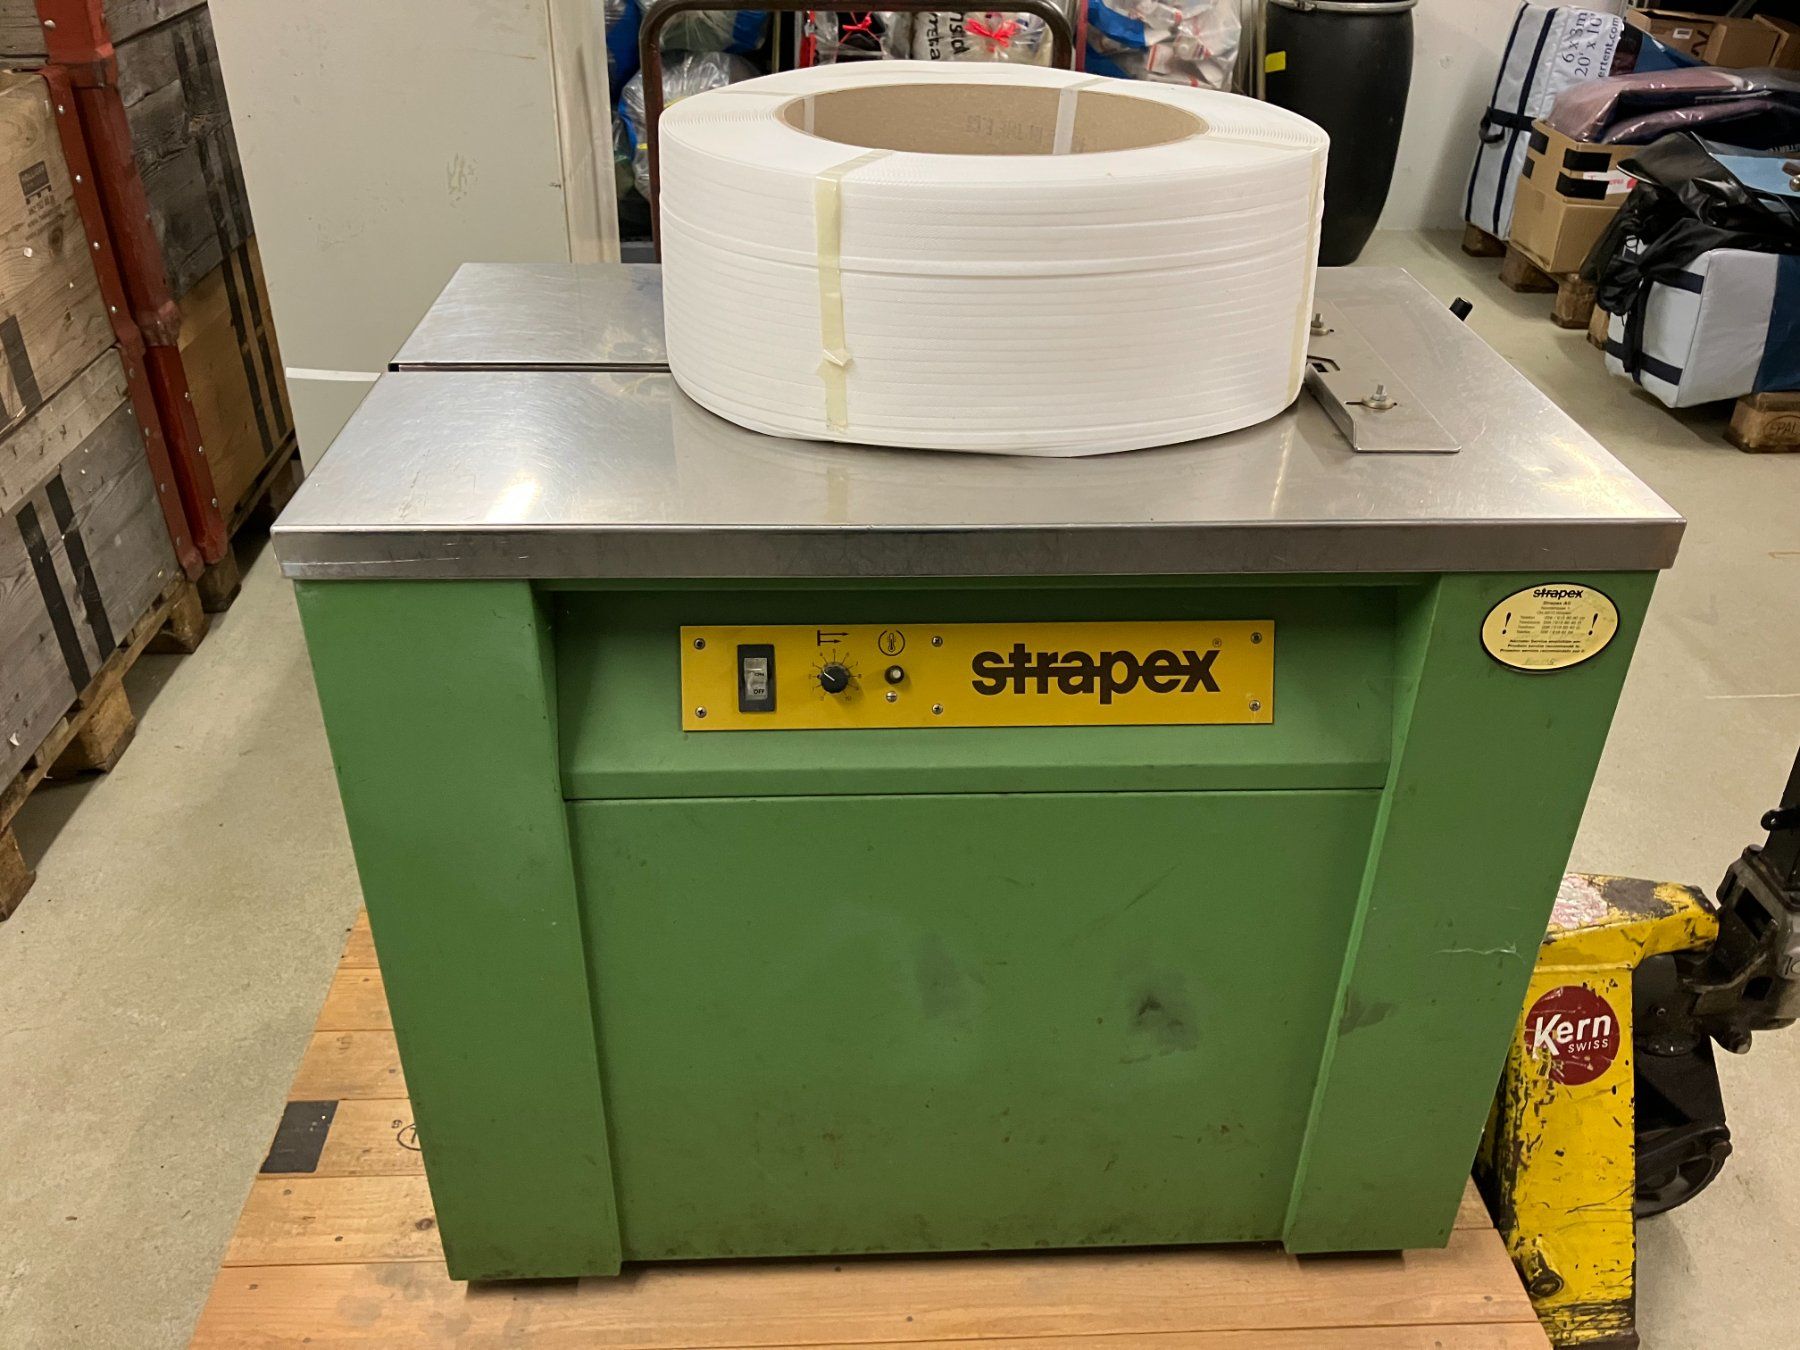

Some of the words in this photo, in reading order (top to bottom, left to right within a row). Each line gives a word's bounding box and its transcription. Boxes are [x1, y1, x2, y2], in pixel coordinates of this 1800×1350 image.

[1562, 53, 1575, 63] 6
[1532, 588, 1584, 600] strapex
[971, 643, 1221, 704] strapex
[1532, 1014, 1612, 1060] Kern
[1567, 1038, 1609, 1053] SWISS
